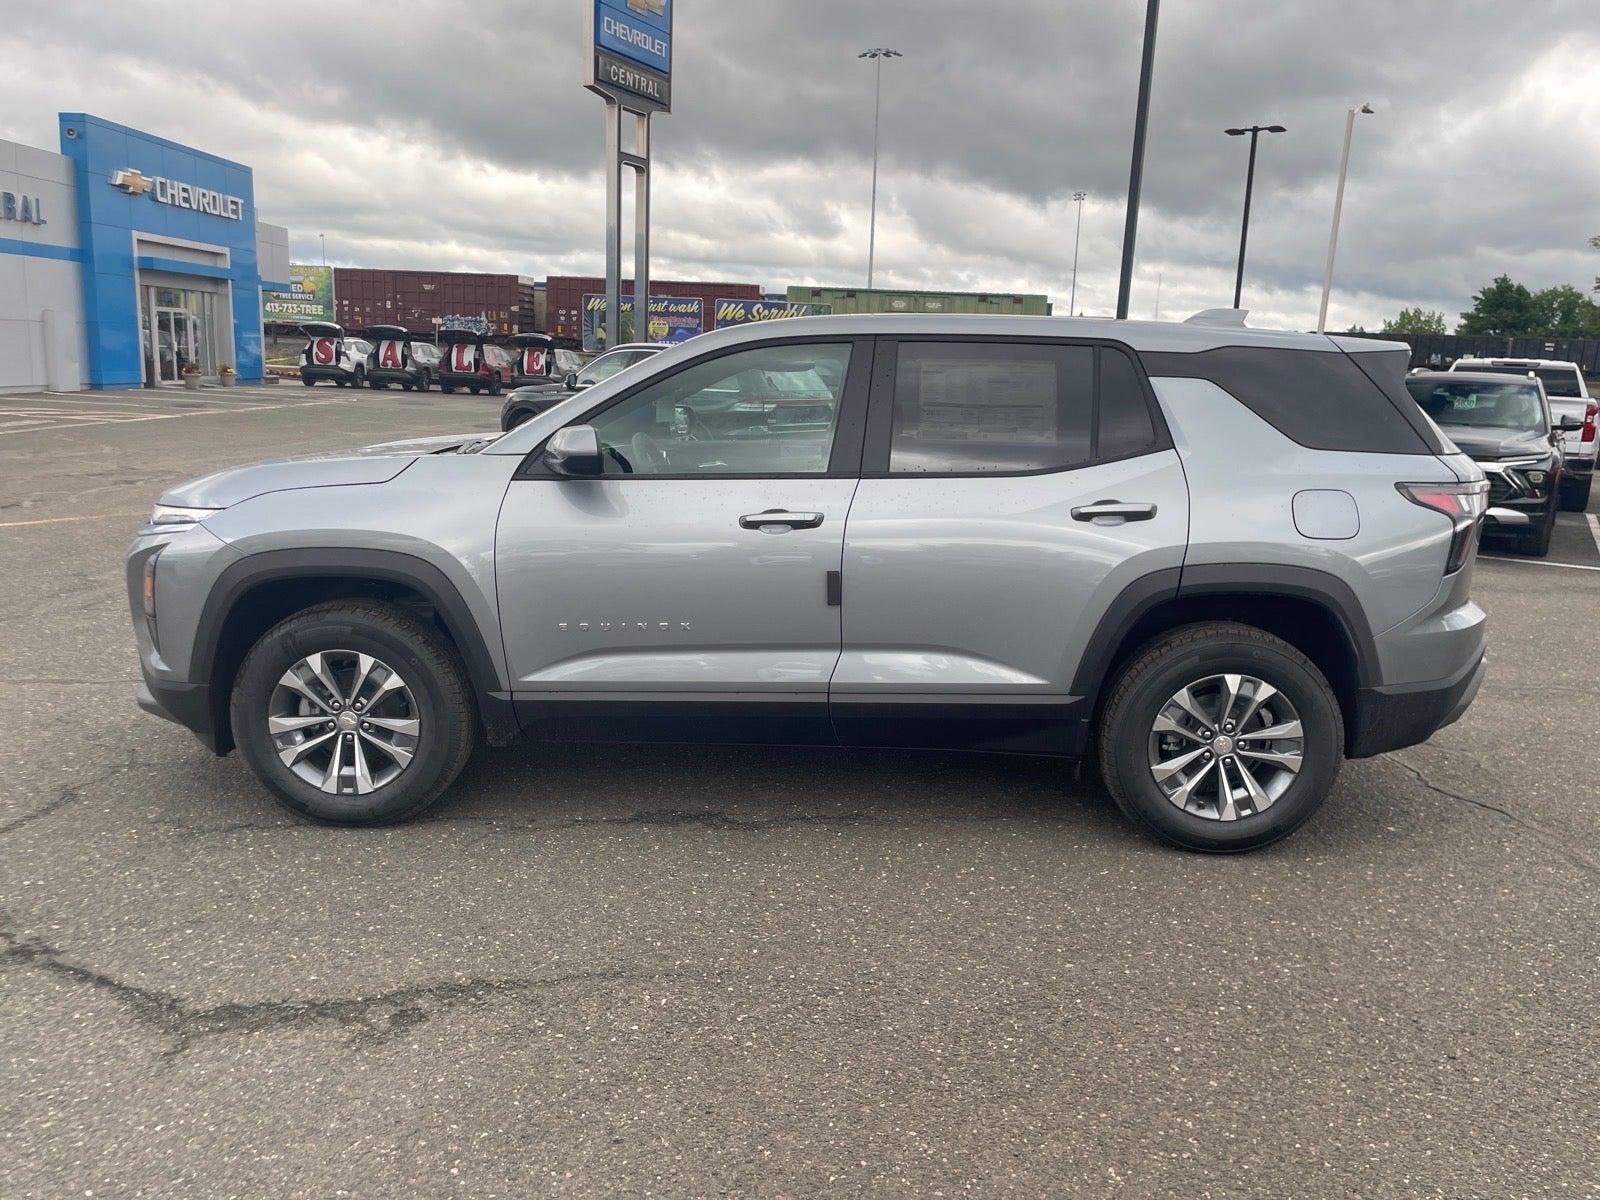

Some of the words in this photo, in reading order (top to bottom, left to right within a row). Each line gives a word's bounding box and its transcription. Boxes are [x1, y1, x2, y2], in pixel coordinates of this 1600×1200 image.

[603, 16, 668, 57] CHEVROLET
[610, 65, 660, 97] CENTRAL
[153, 176, 244, 220] CHEVROLET
[292, 293, 314, 301] SERVICE
[587, 297, 607, 311] We
[669, 300, 700, 313] wash
[265, 302, 324, 315] 413-733-TREE
[716, 302, 745, 321] We
[558, 622, 692, 632] EQUINOX
